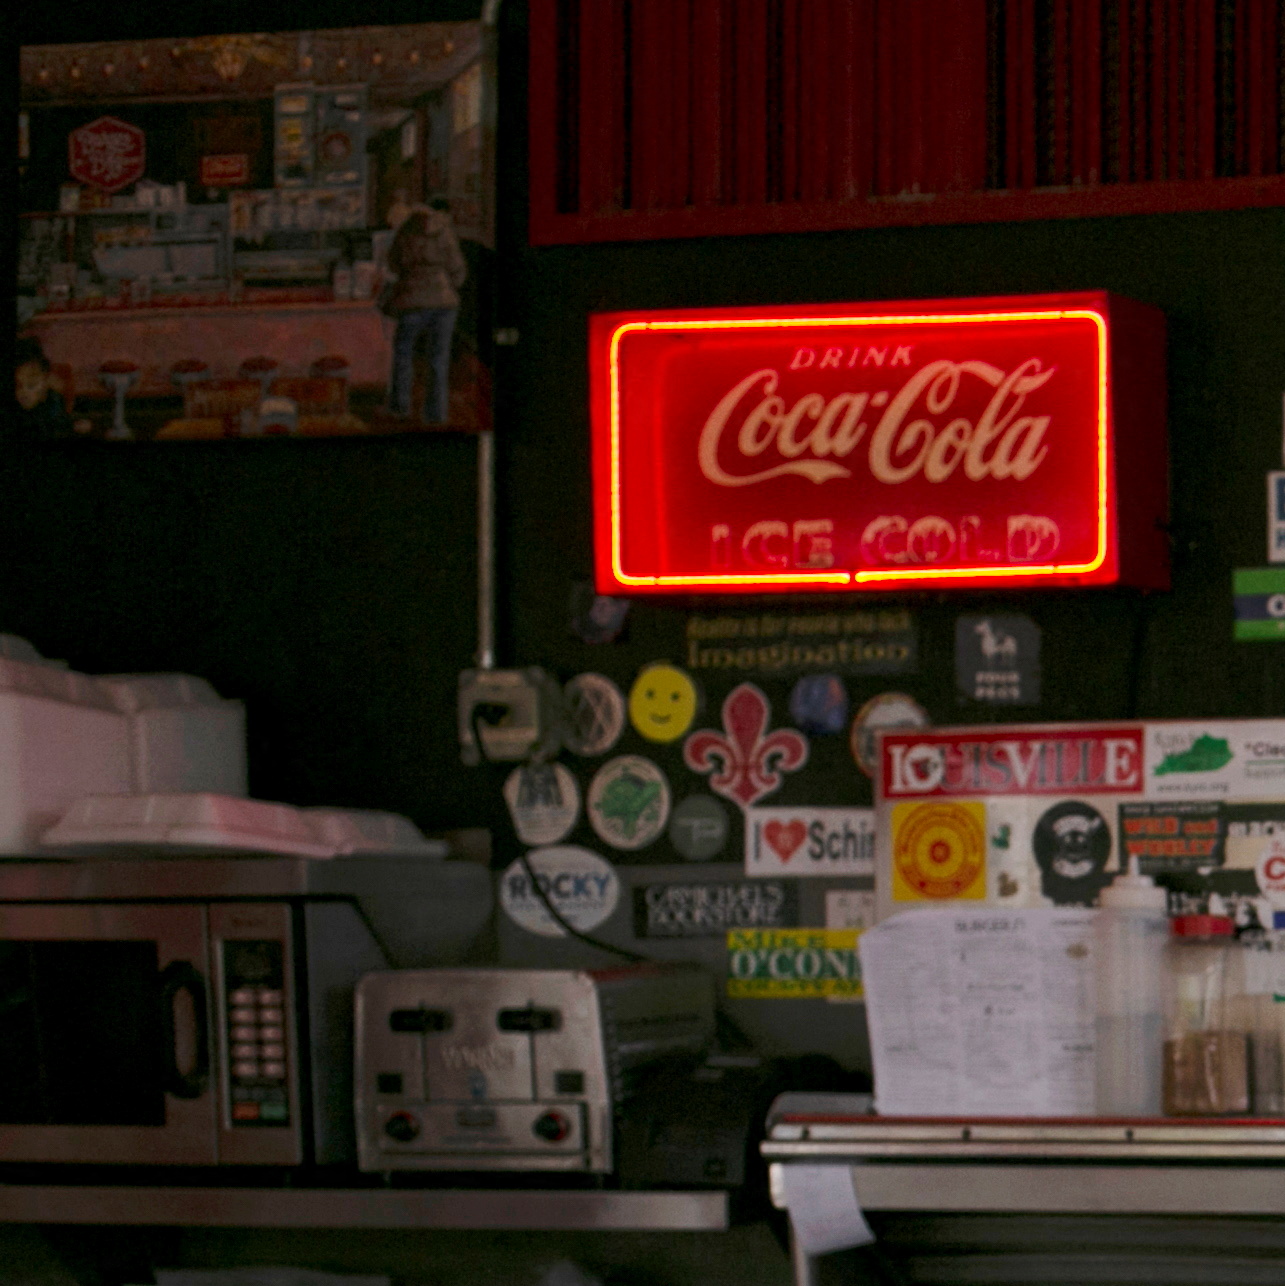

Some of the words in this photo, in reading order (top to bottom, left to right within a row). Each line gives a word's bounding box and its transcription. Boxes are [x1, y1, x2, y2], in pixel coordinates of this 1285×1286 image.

[790, 345, 914, 371] DRINK
[699, 358, 1057, 486] Coca-Cola
[711, 517, 836, 568] ICE
[860, 514, 1060, 564] COLD
[510, 869, 612, 899] ROCKY
